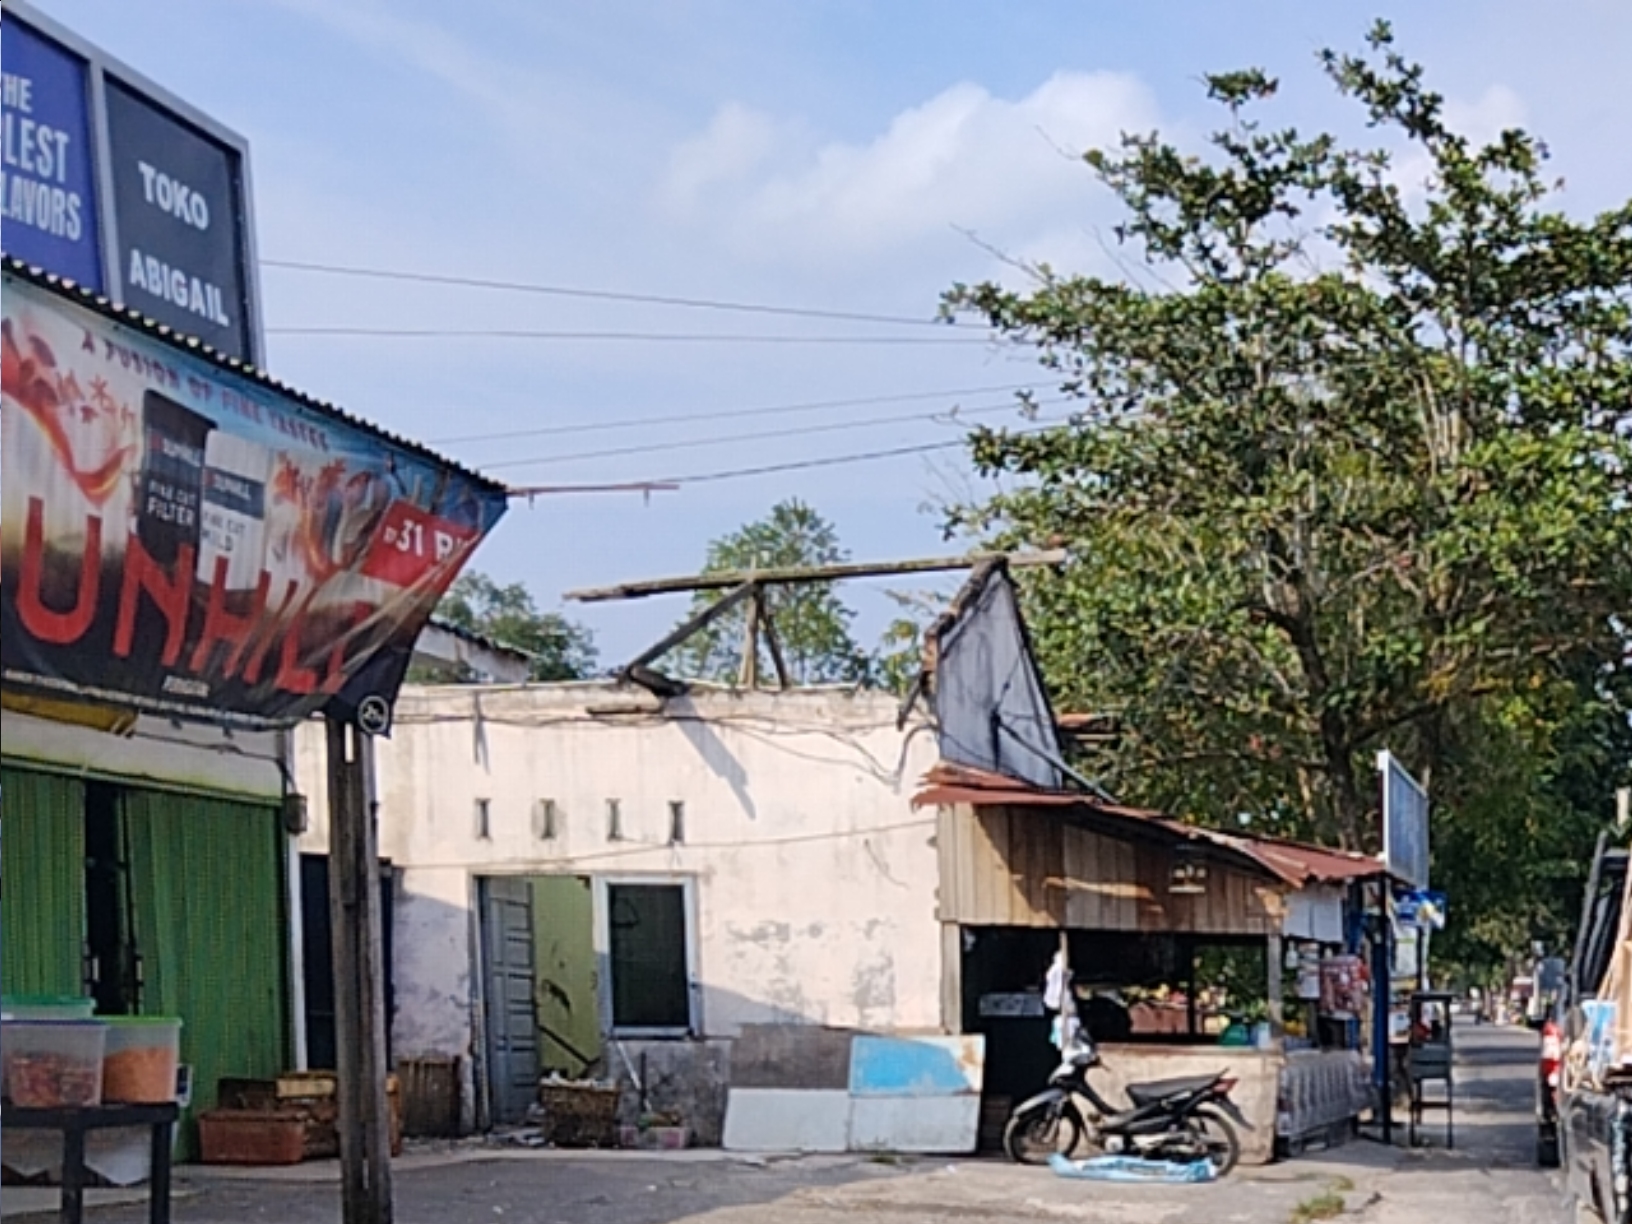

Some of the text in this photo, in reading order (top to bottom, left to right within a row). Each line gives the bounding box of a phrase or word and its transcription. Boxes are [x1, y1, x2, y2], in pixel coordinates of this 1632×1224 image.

[1, 112, 70, 183] LEST
[138, 160, 209, 231] TOKO
[130, 248, 229, 327] ABIGAIL
